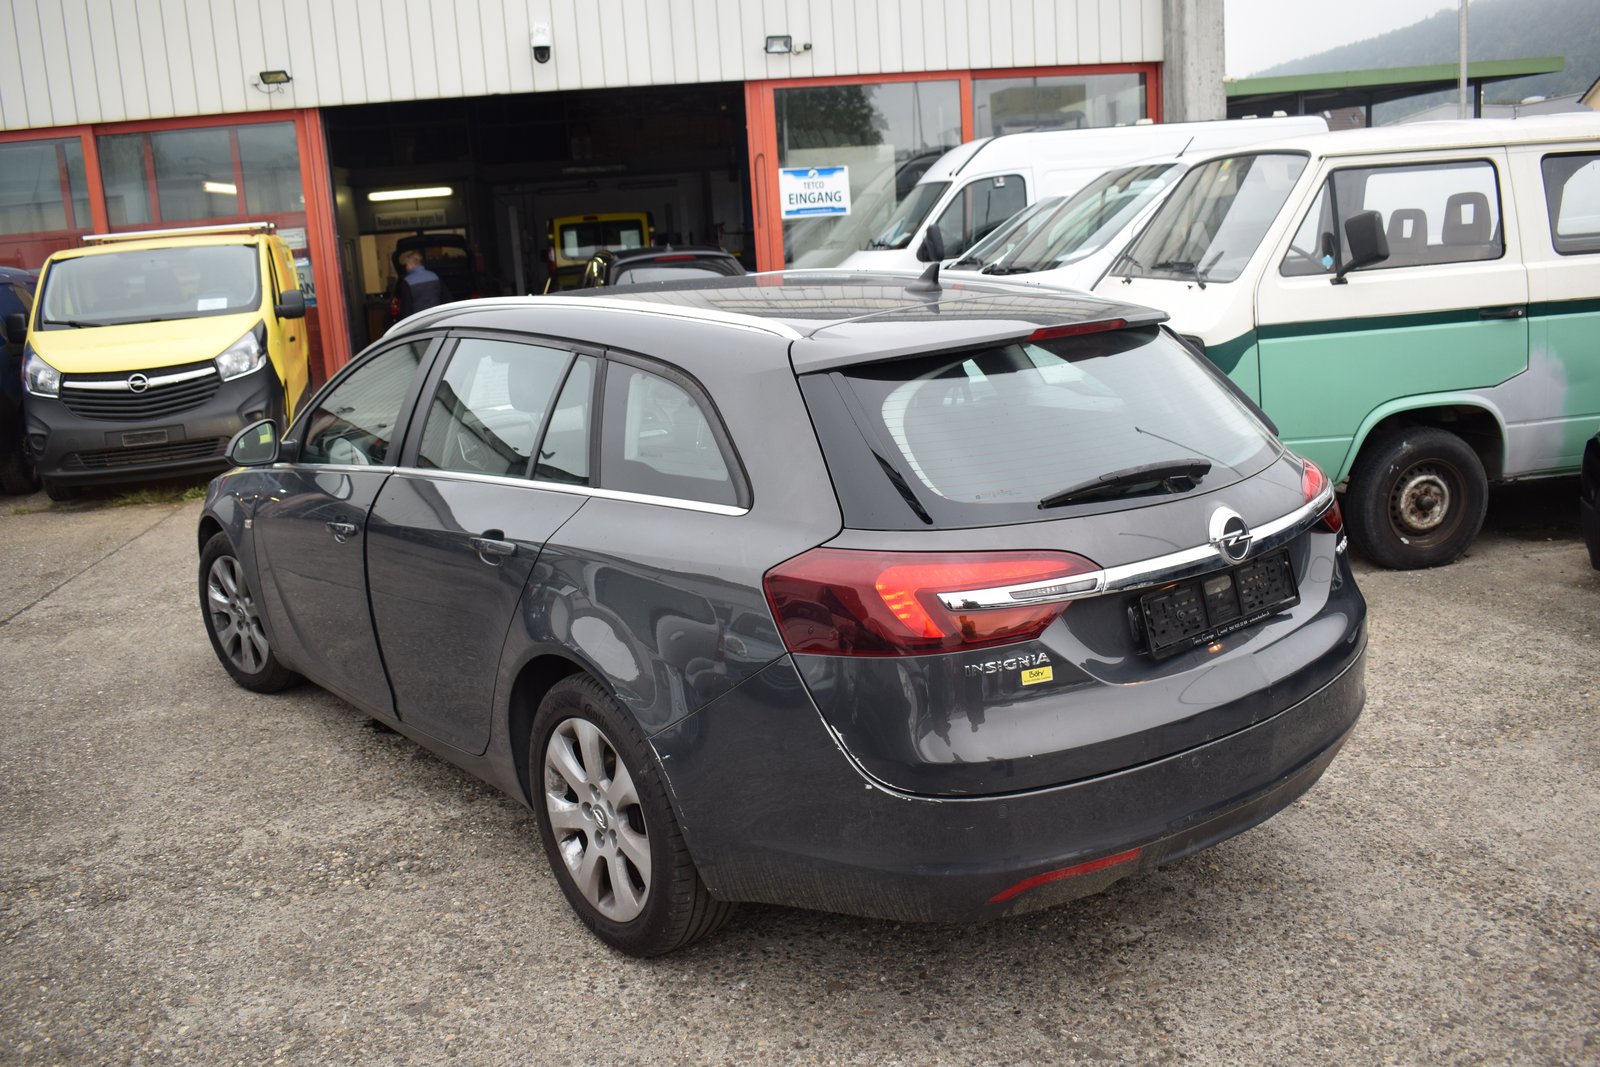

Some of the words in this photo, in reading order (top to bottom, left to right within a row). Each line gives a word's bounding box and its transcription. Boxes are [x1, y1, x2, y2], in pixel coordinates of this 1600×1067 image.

[803, 181, 825, 189] TETCO
[788, 190, 842, 205] EINGANG
[964, 652, 1051, 677] INSIGNIA
